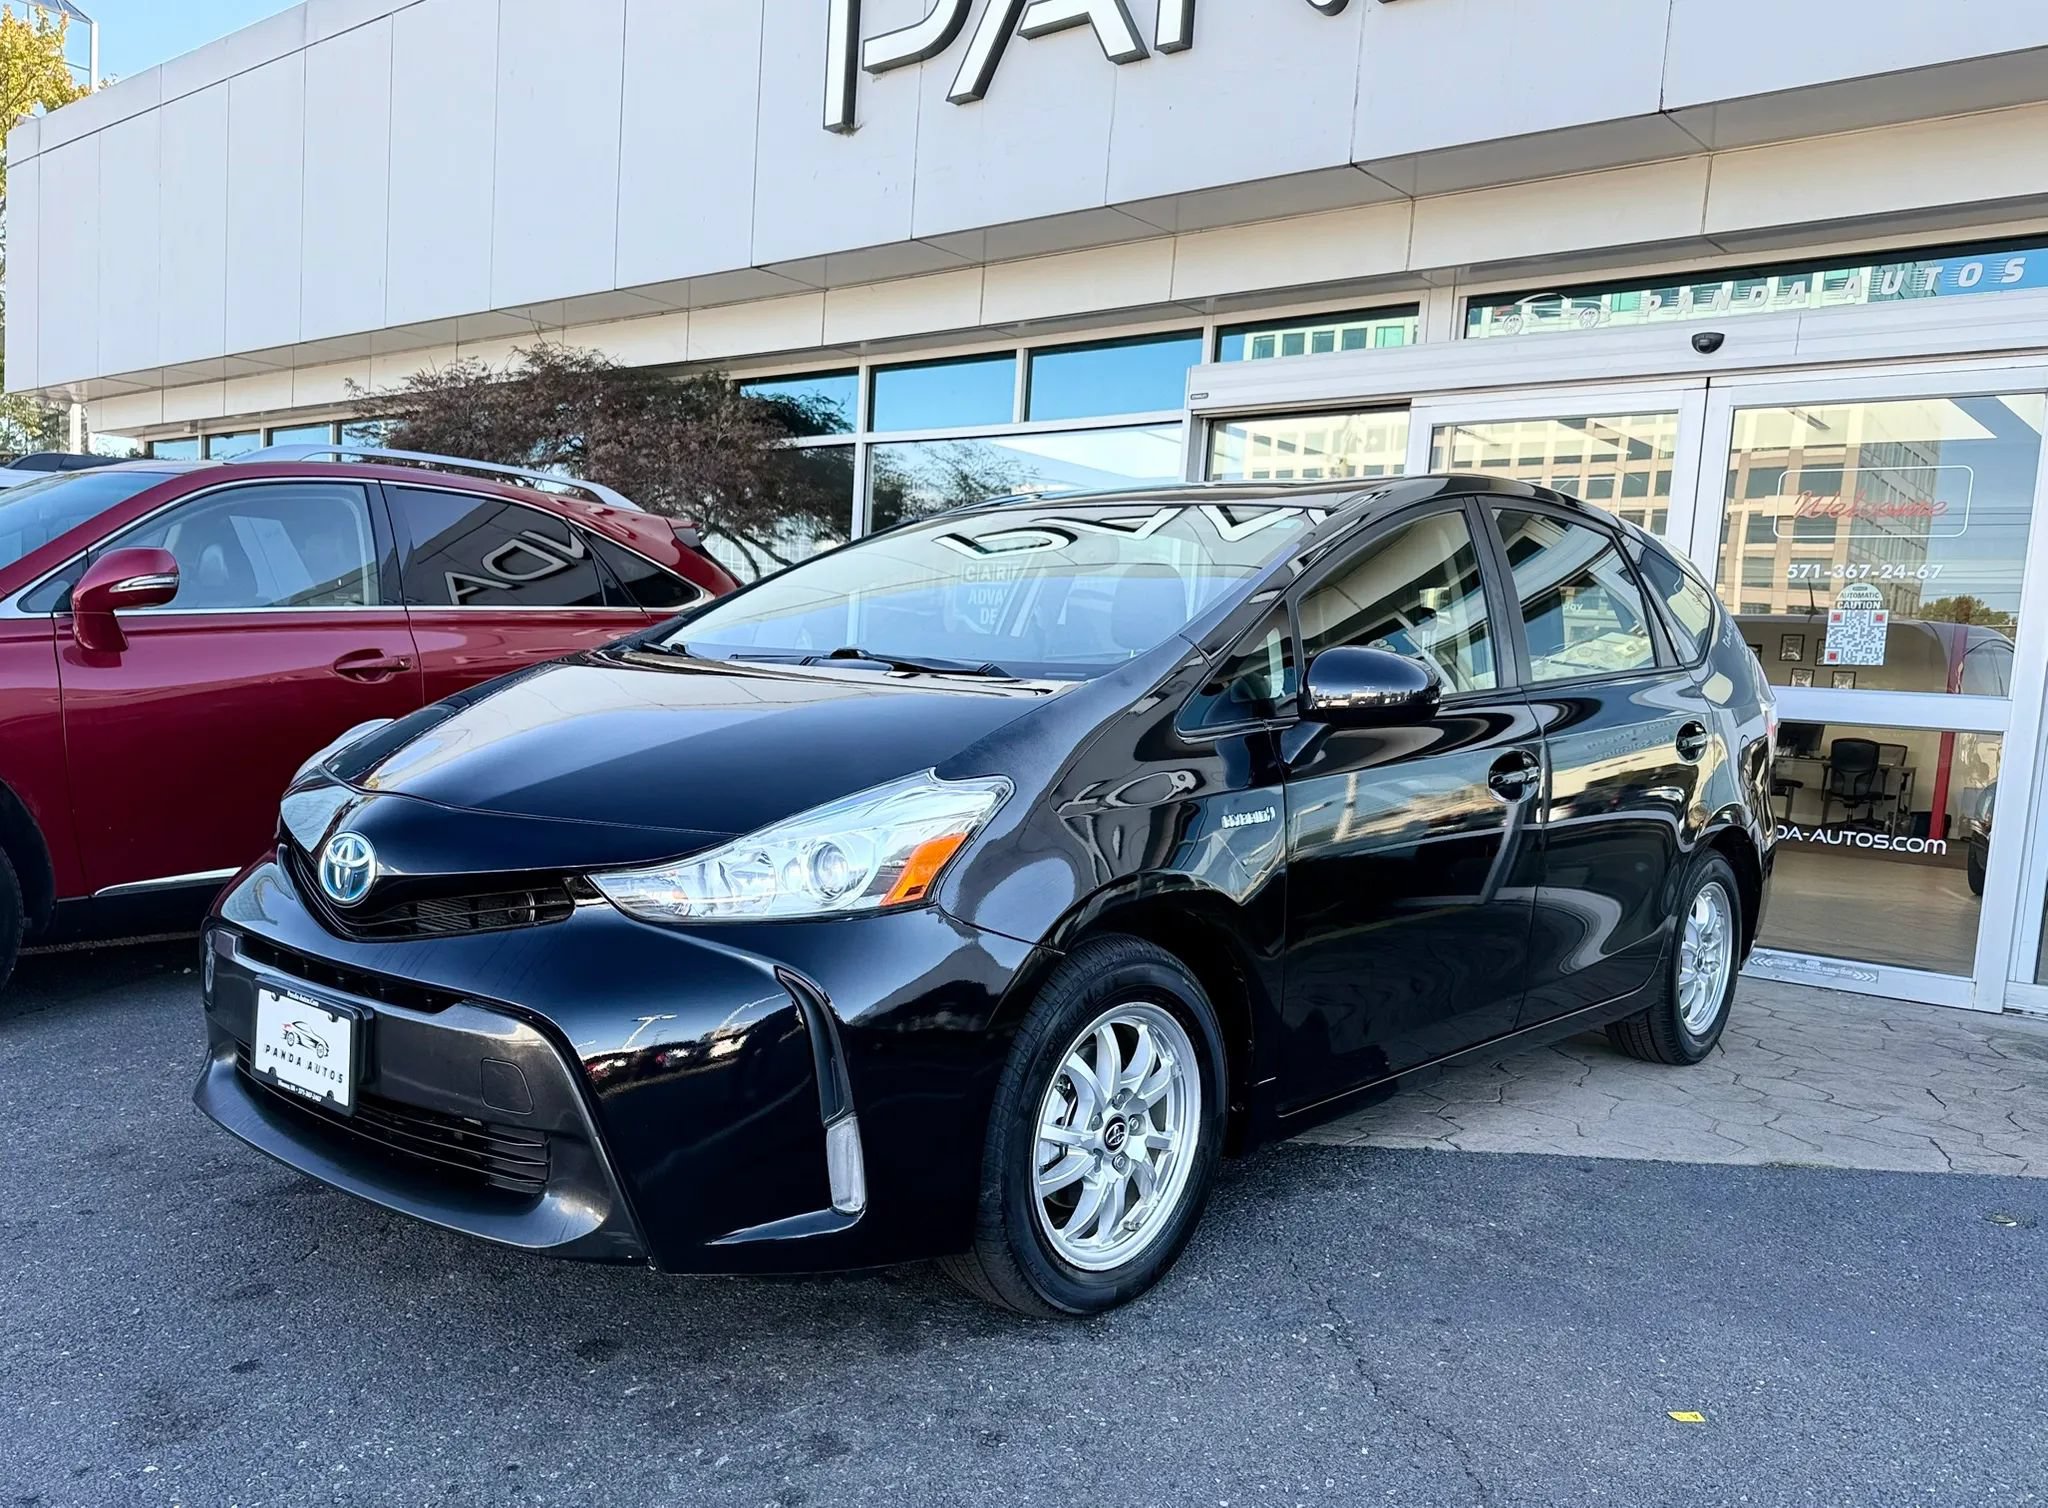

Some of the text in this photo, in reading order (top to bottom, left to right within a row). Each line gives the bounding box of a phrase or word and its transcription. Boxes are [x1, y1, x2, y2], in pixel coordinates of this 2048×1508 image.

[1638, 257, 2028, 317] PANDA AUTOS
[1793, 489, 1950, 519] Welcome
[1787, 563, 1944, 580] 571-367-24-67
[1836, 600, 1881, 610] CAUTION
[1839, 591, 1880, 599] AUTOMATIC
[264, 1044, 344, 1084] PANDA AUTOS
